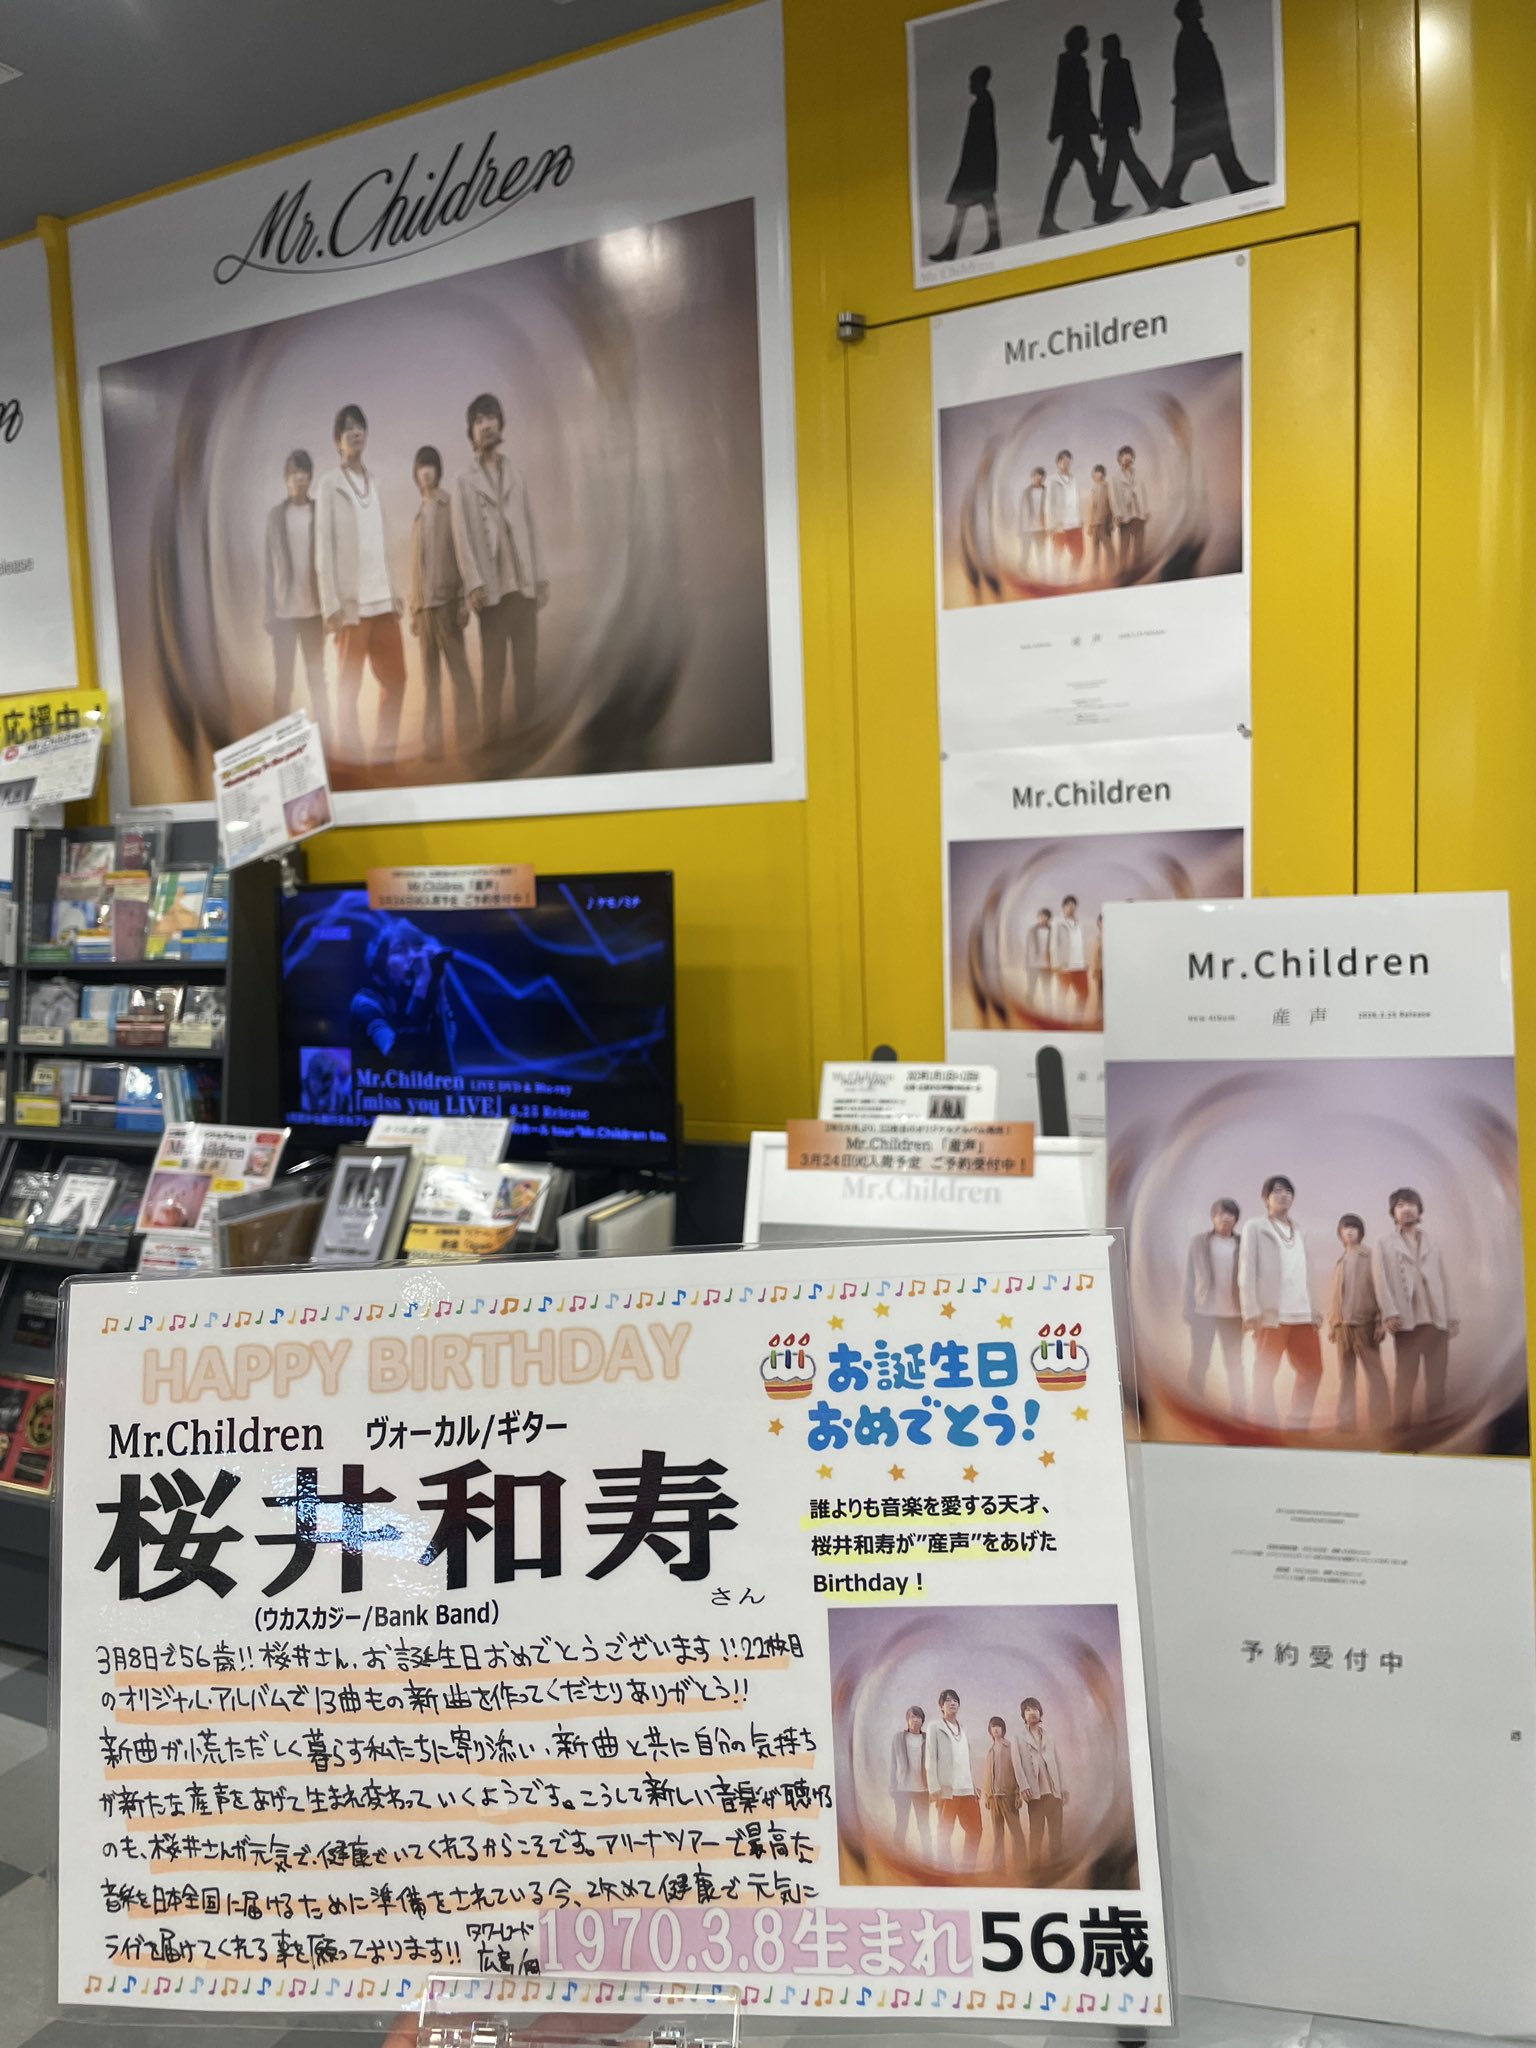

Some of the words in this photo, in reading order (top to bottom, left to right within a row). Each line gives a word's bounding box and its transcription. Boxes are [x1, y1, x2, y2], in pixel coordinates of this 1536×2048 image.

[213, 131, 575, 285] Mr.Children
[1003, 311, 1168, 365] Mr.Children
[1012, 779, 1170, 810] Mr.Children
[1187, 947, 1430, 981] Mr.Children
[1272, 1006, 1327, 1027] 産声
[356, 1069, 465, 1092] Mr.Children
[407, 1096, 440, 1116] you
[842, 1175, 1001, 1204] Mr.Children
[141, 1338, 351, 1404] HAPPY
[368, 1322, 693, 1393] BIRTHDAY
[828, 1340, 1018, 1393] お誕生日
[108, 1417, 325, 1460] Mr.Children
[366, 1410, 568, 1451] ヴォーカル/ギター
[807, 1395, 1040, 1451] おめでとう!
[94, 1450, 740, 1602] 桜井和寿
[710, 1584, 767, 1605] さん
[809, 1494, 1050, 1520] 誰よりも音楽を愛する天才、
[435, 1599, 500, 1627] Band)
[1241, 1639, 1403, 1674] 予約受付中
[540, 1906, 976, 1978] 1970.3.8生まれ
[982, 1904, 1154, 1978] 56歳
